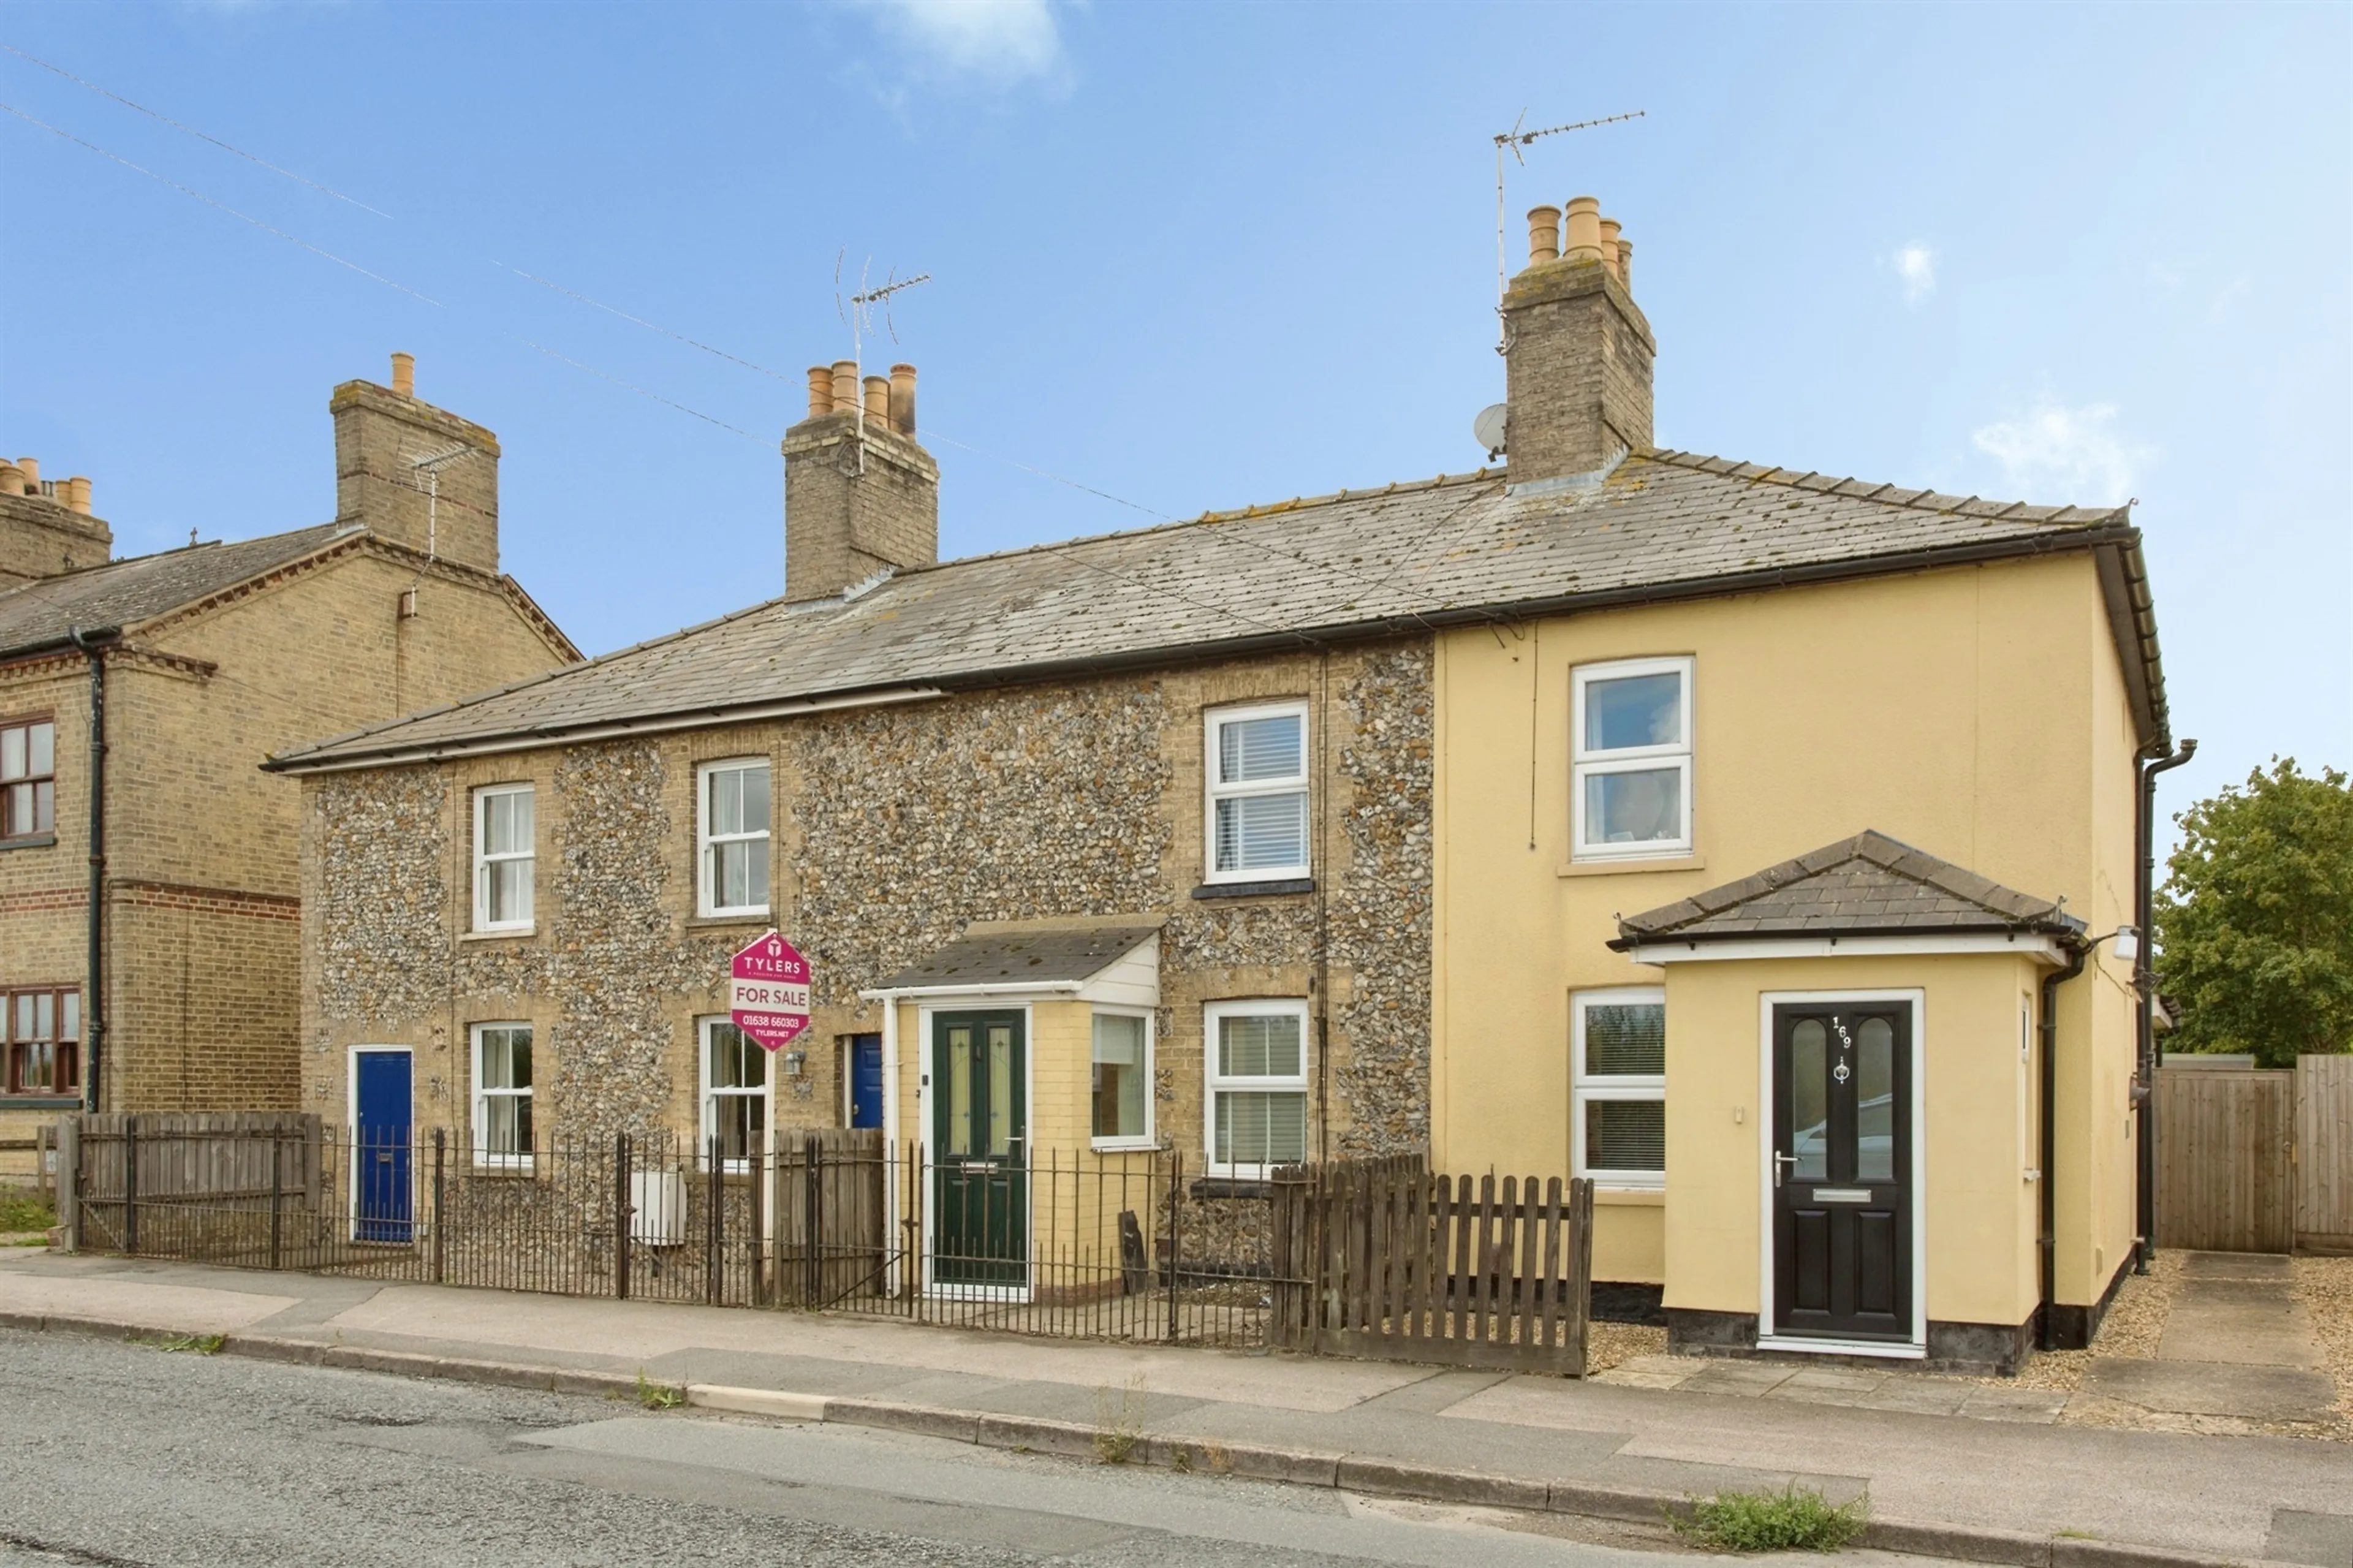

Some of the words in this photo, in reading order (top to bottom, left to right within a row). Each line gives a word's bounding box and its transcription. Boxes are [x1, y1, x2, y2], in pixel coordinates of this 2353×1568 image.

[744, 956, 800, 974] TYLERS
[737, 987, 769, 1004] FOR
[773, 990, 806, 1007] SALE
[743, 1015, 770, 1026] 01638
[771, 1017, 799, 1028] 660303
[756, 1029, 789, 1037] TYLERS.NET
[1833, 1016, 1851, 1049] 169
